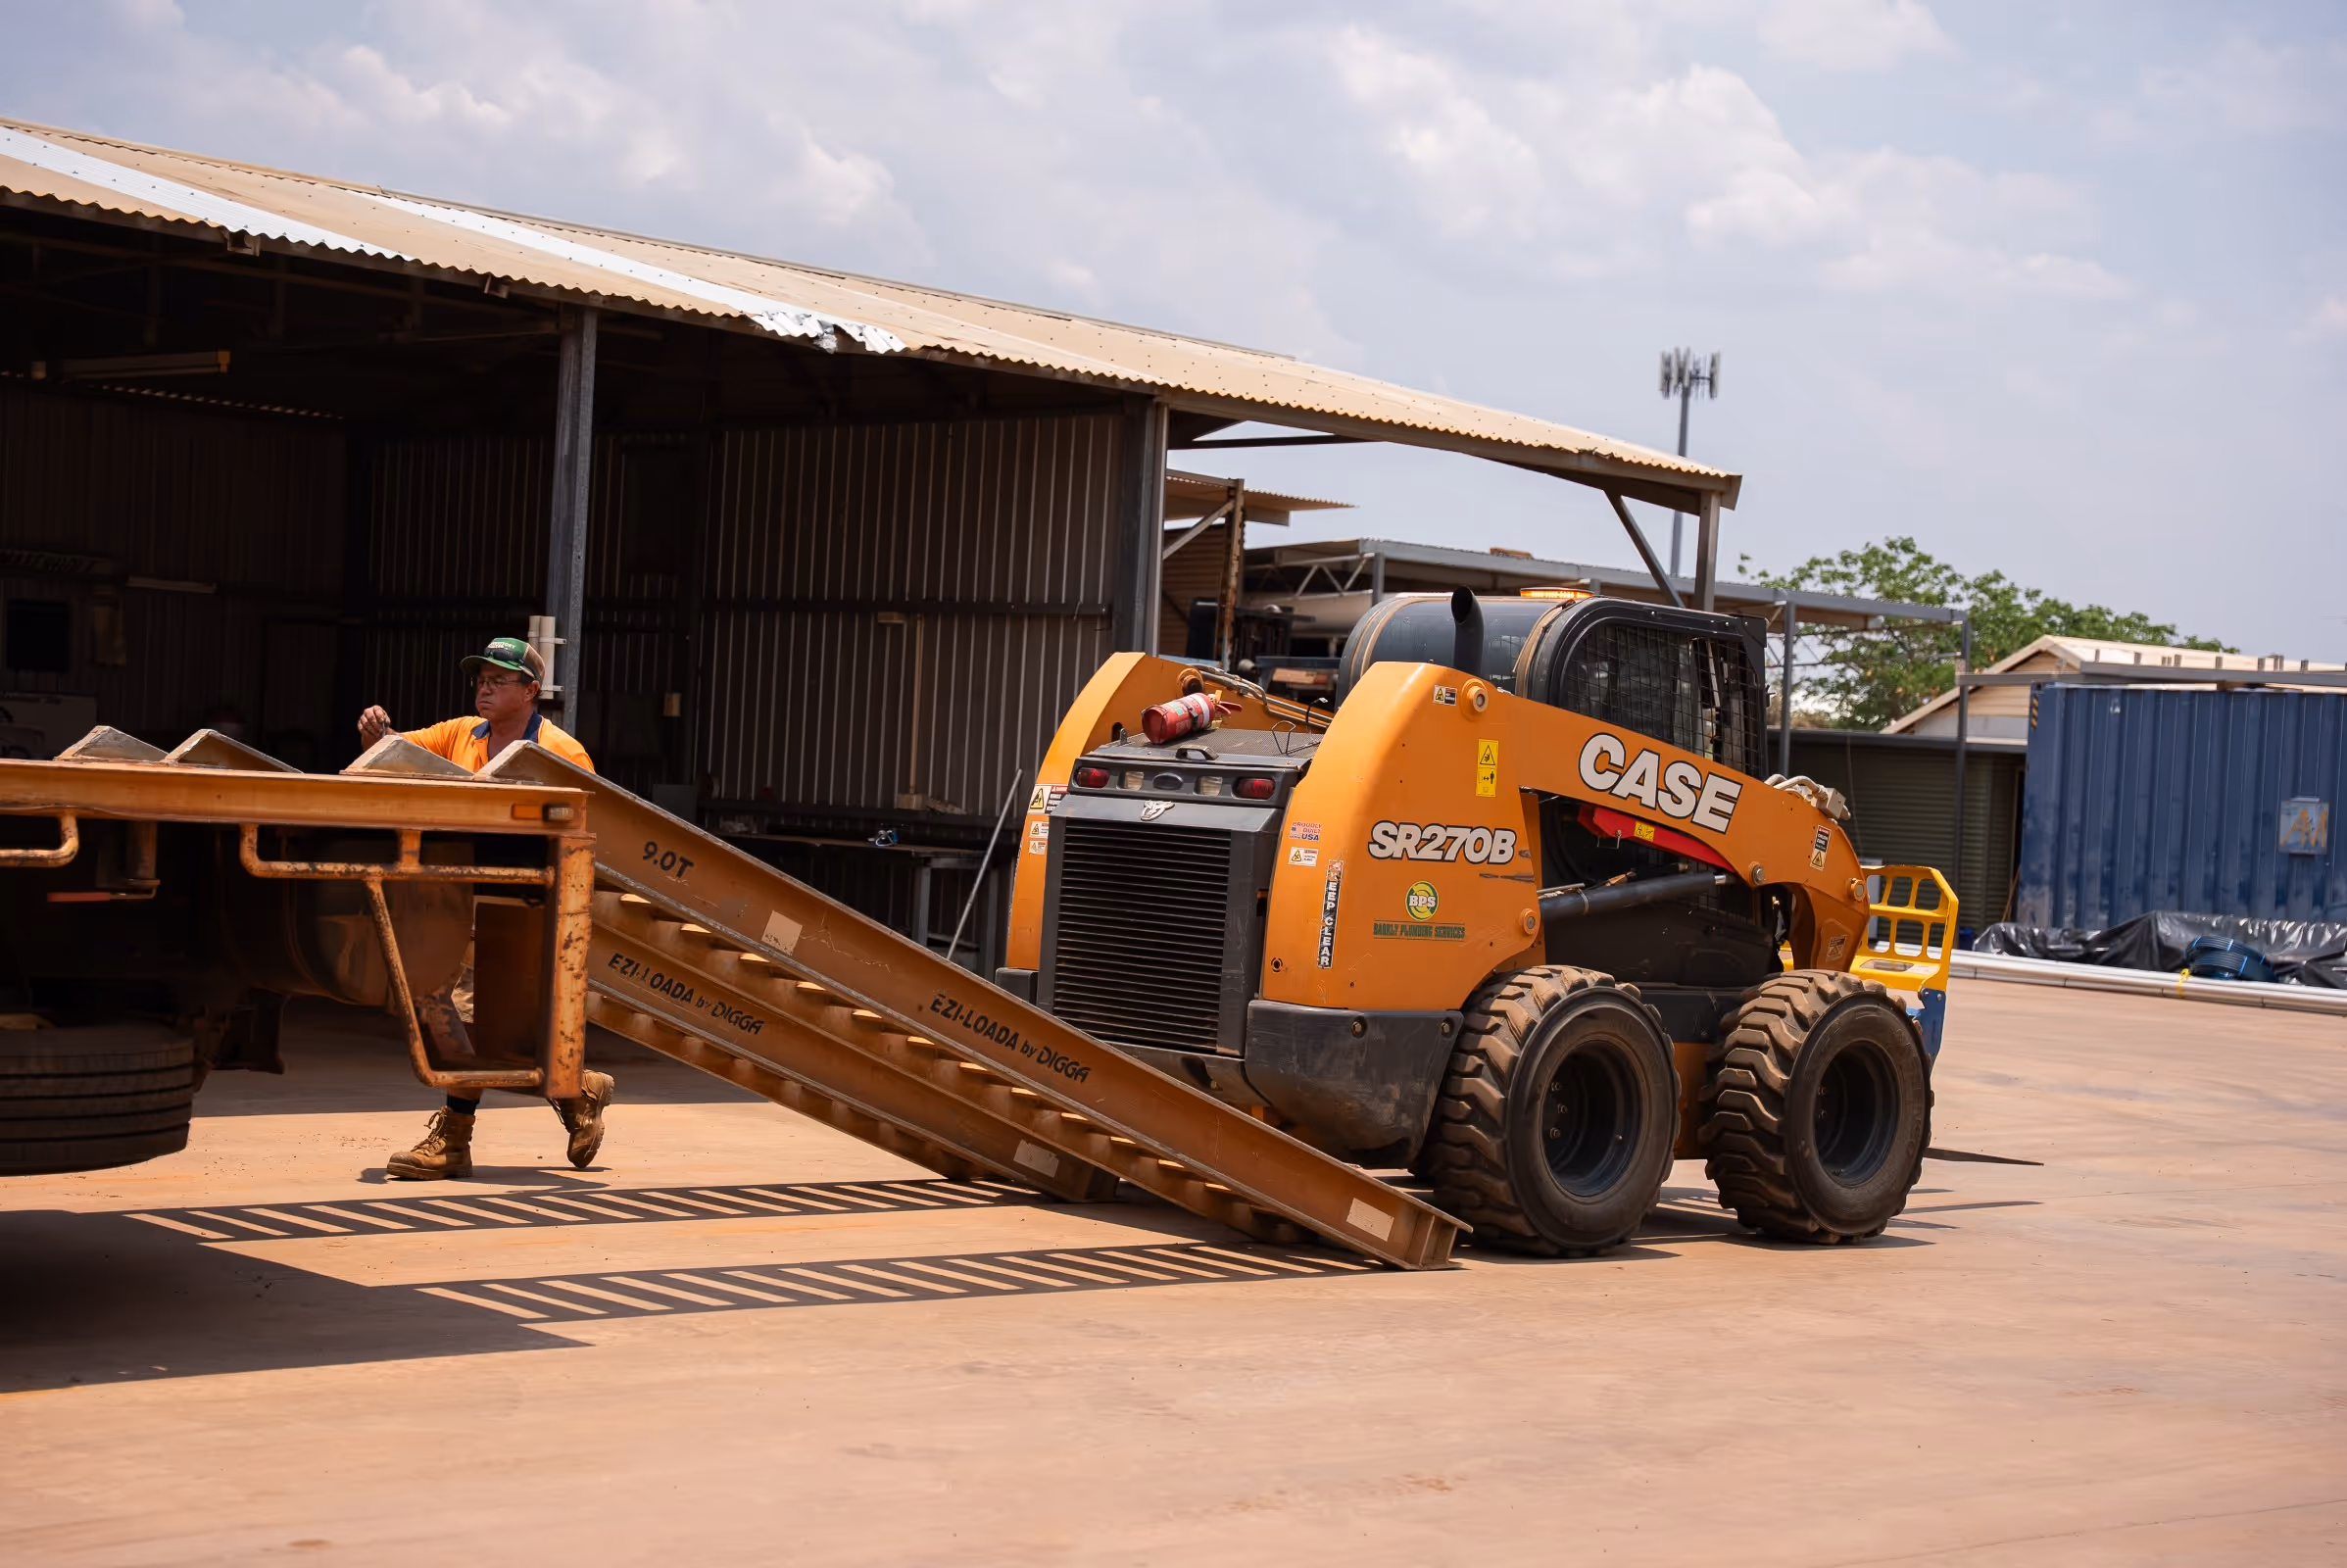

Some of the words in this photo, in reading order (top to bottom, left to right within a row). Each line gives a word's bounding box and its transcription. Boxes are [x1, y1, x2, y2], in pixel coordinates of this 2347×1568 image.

[1579, 732, 1743, 835] CASE
[643, 841, 695, 879] 9.0T
[1368, 820, 1517, 864] SR270B
[1408, 895, 1437, 907] BPS
[1320, 916, 1334, 966] CLEAR
[1435, 926, 1465, 939] SERVICES
[710, 1001, 764, 1035] DIGGA
[1020, 1039, 1039, 1058] by
[1036, 1045, 1092, 1083] DIGGA
